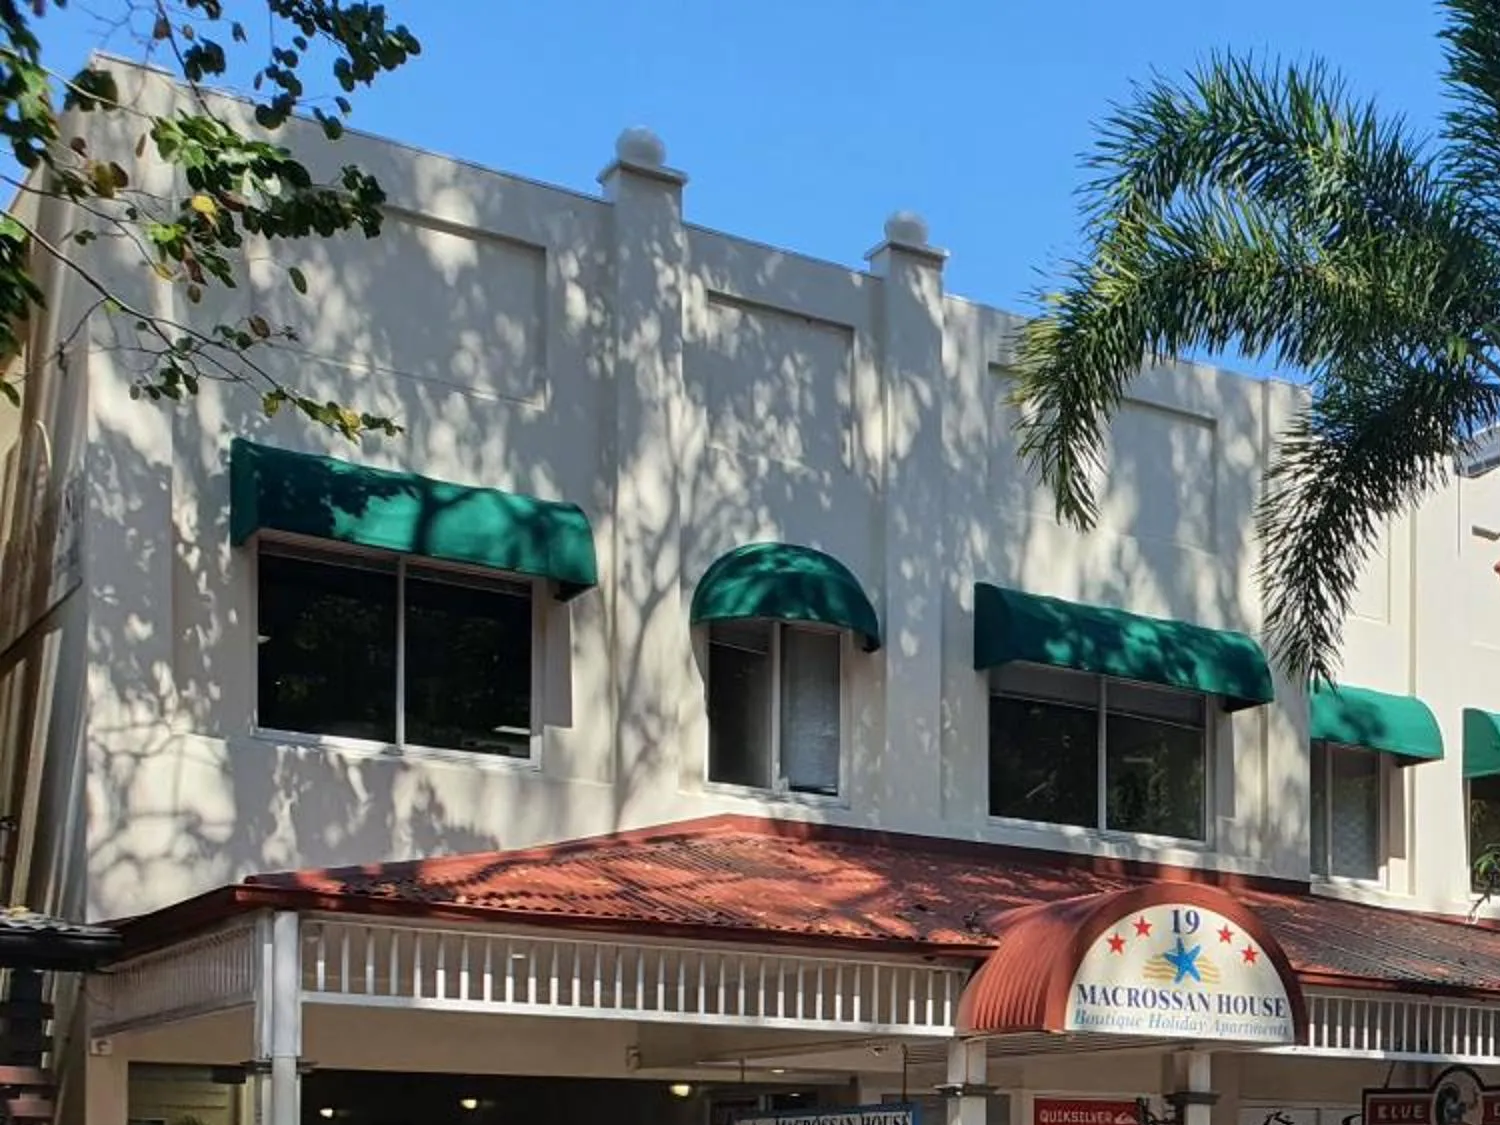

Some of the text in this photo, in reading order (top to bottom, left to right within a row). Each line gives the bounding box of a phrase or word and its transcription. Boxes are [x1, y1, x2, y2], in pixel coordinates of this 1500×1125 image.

[1171, 909, 1201, 935] 19
[1076, 983, 1287, 1018] MACROSSAN HOUSE
[1074, 1010, 1290, 1038] Boutique Holiday Apartments
[1039, 1111, 1114, 1125] QUIKSILVER
